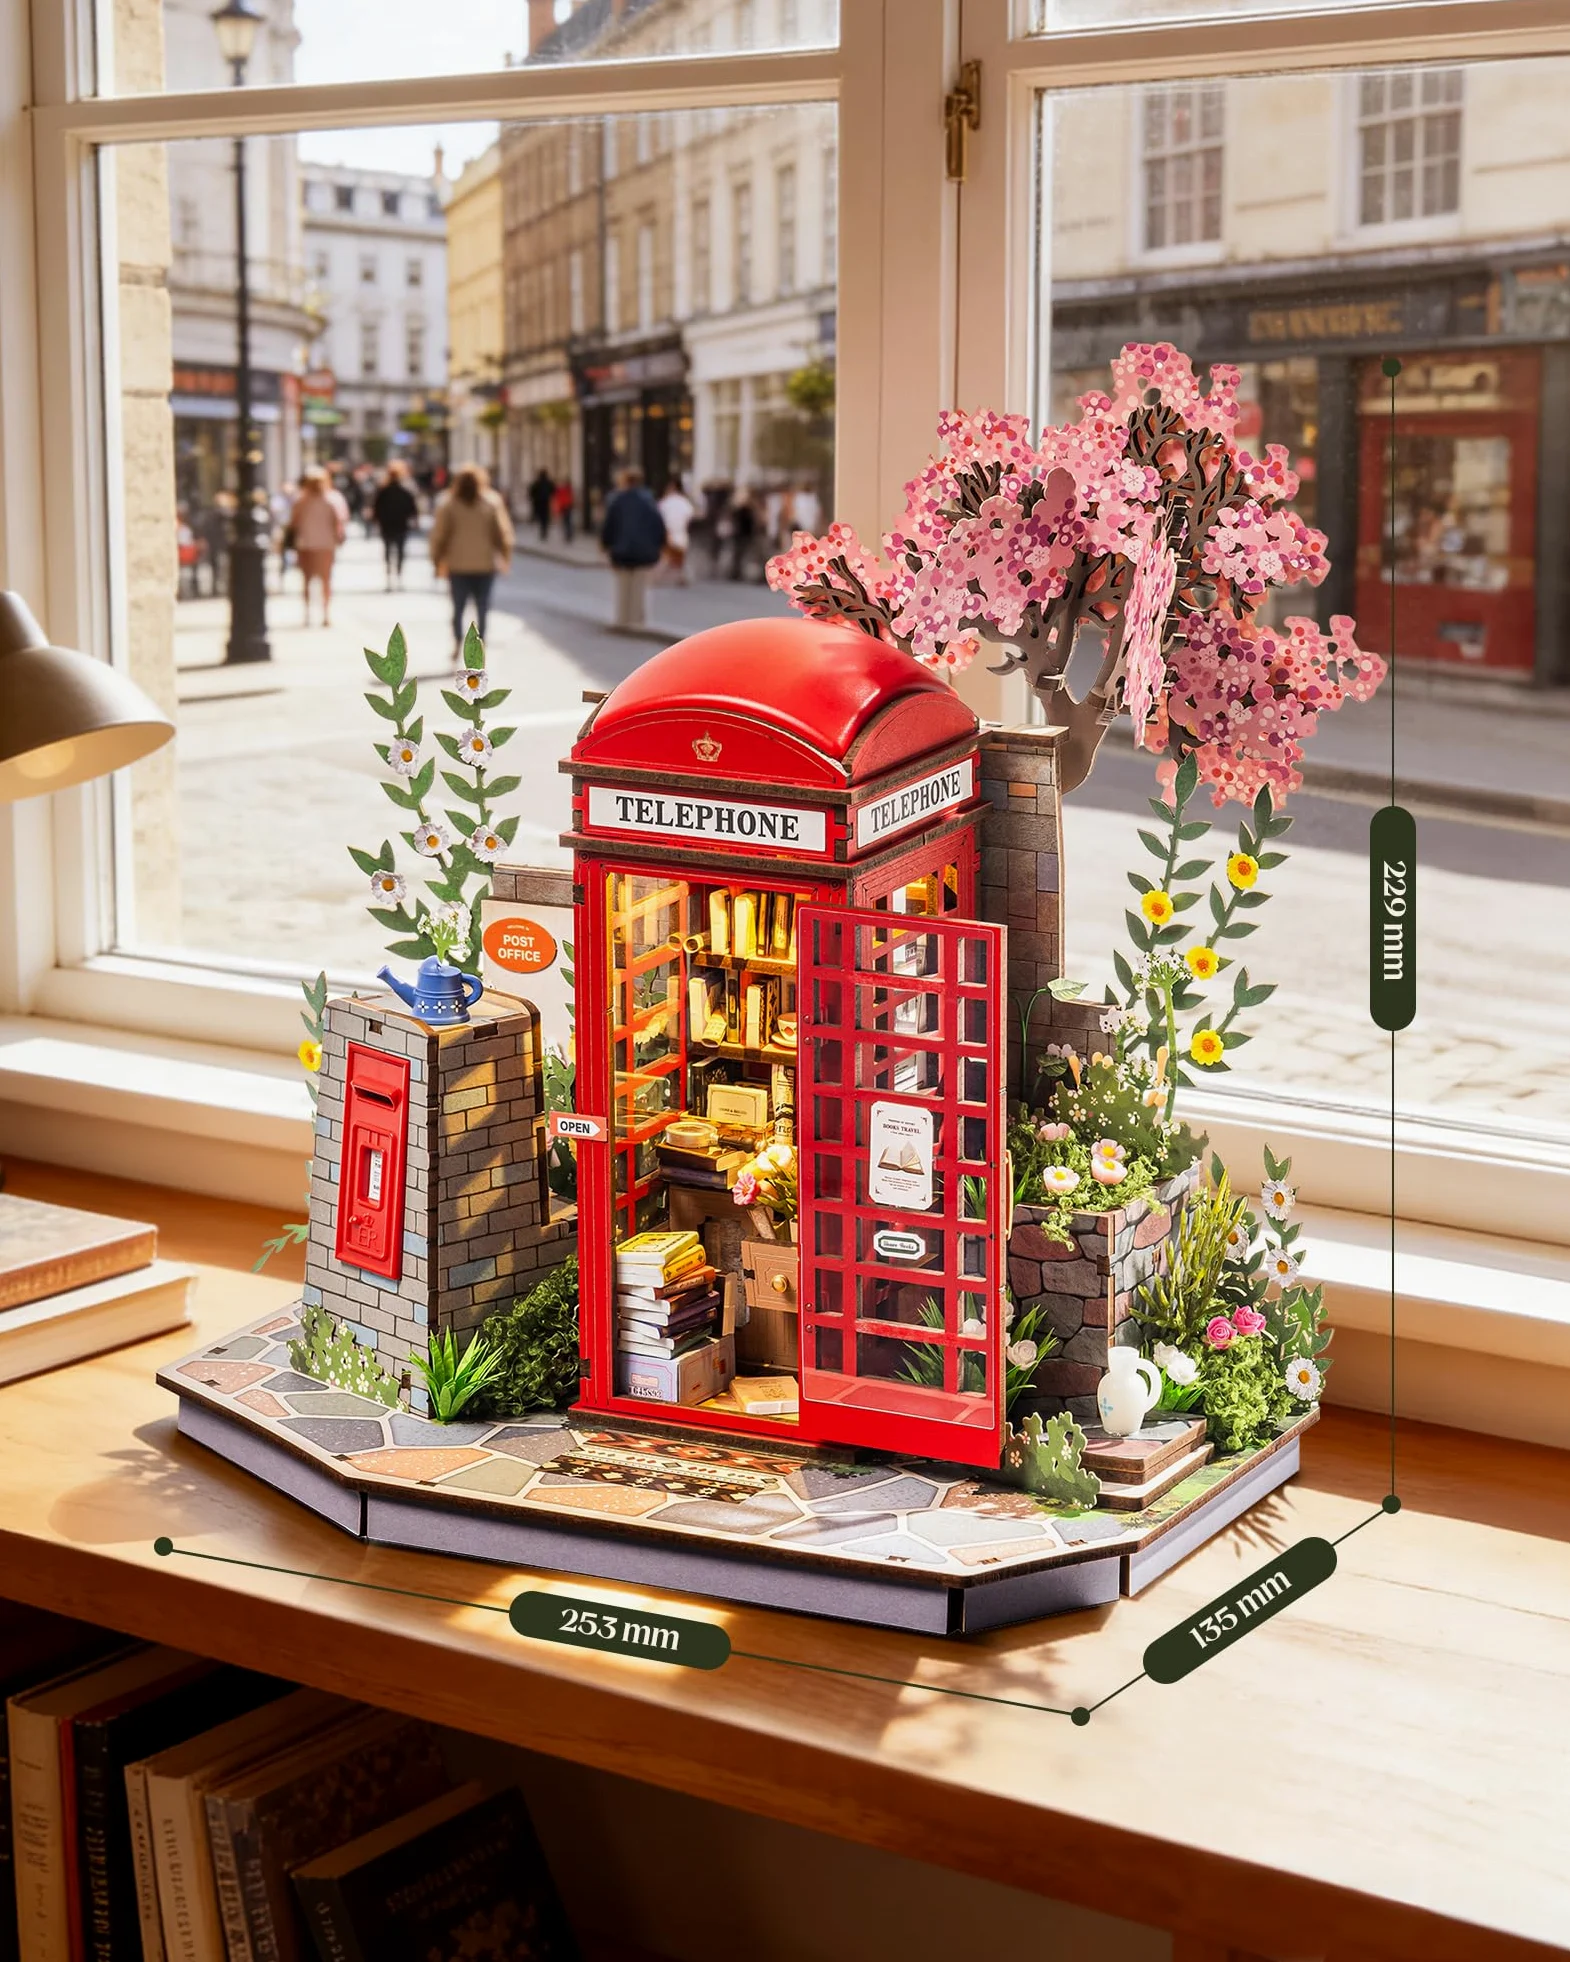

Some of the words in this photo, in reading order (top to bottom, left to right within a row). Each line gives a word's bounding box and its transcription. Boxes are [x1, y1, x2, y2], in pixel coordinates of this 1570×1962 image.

[870, 770, 961, 834] TELEPHONE
[615, 795, 801, 842] TELEPHONE
[502, 934, 535, 949] POST
[497, 948, 542, 963] OFFICE
[559, 1120, 591, 1135] OPEN
